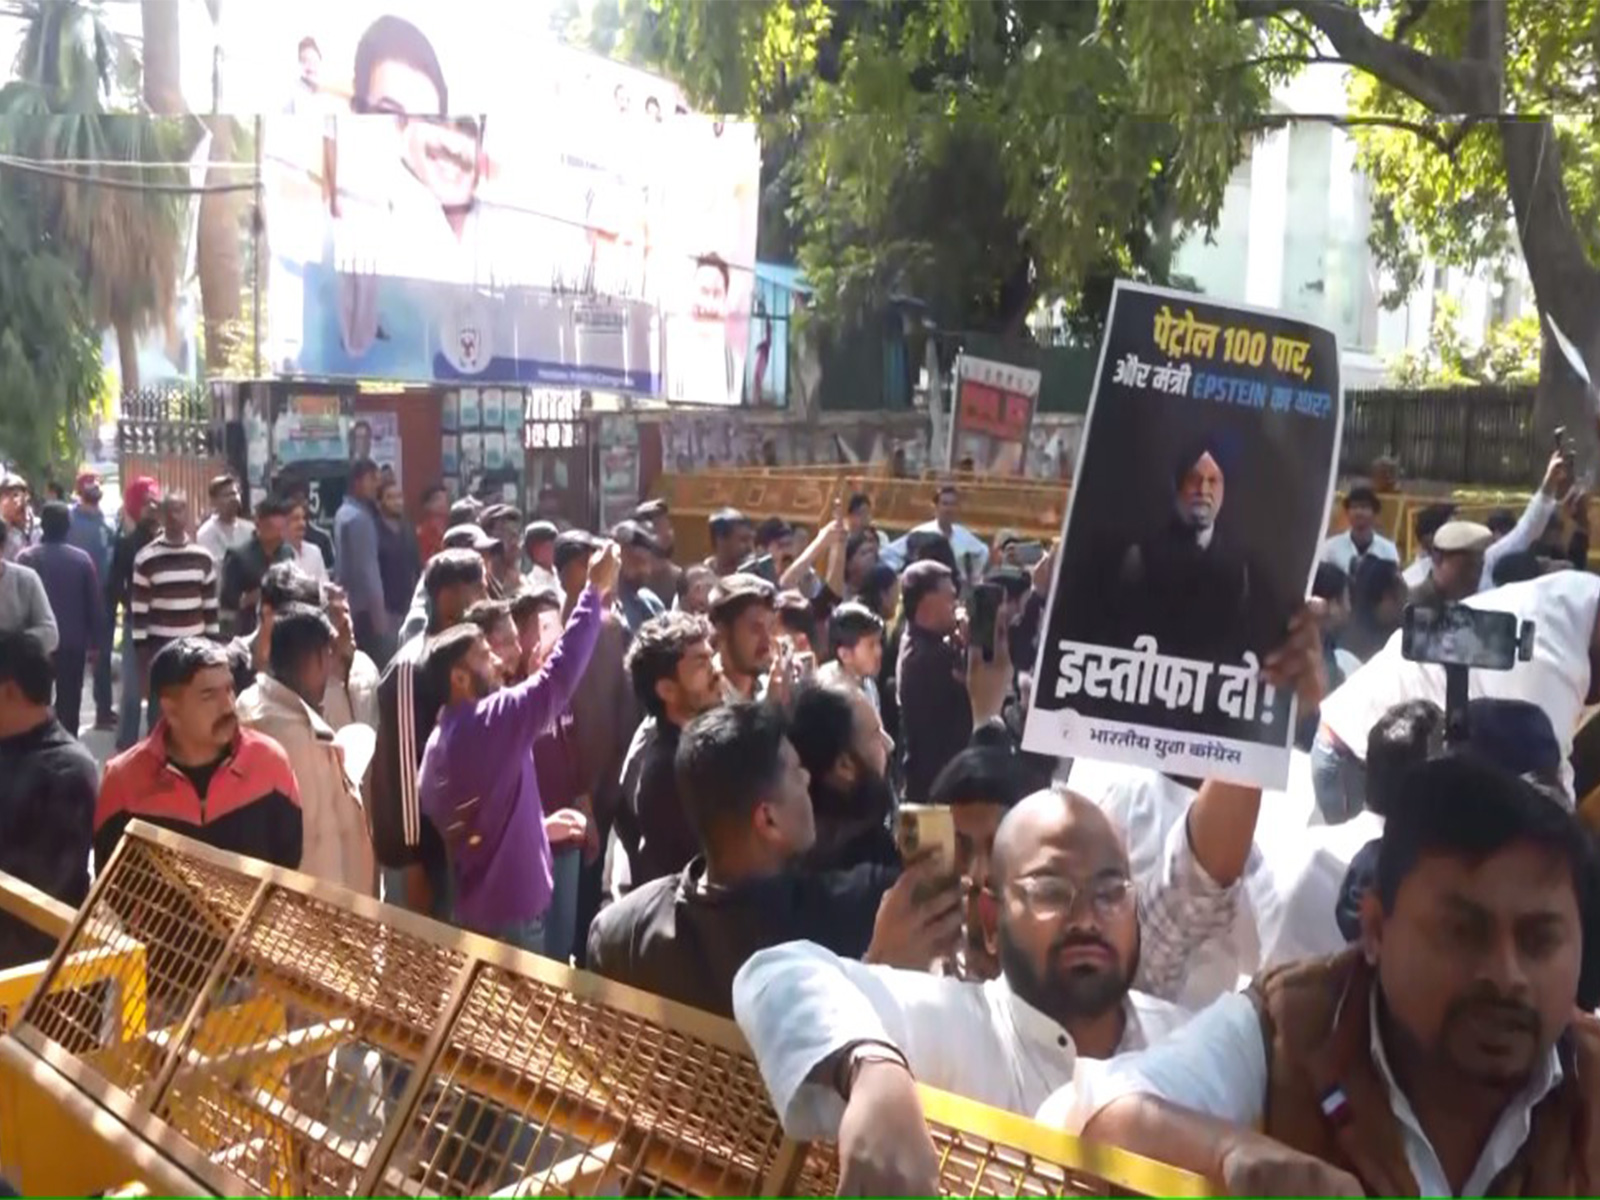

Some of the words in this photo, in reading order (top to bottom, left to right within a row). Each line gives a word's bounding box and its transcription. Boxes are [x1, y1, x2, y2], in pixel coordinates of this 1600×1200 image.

[1153, 306, 1220, 360] पेट्रोल
[1223, 327, 1267, 367] 100
[1271, 335, 1313, 381] पार,
[1112, 353, 1151, 388] और
[1152, 361, 1192, 397] मंत्री
[1192, 373, 1268, 410] EPSTEIN
[1055, 634, 1214, 714] इस्तीफा
[1089, 727, 1151, 751] भारतीय
[1153, 738, 1185, 759] युवा
